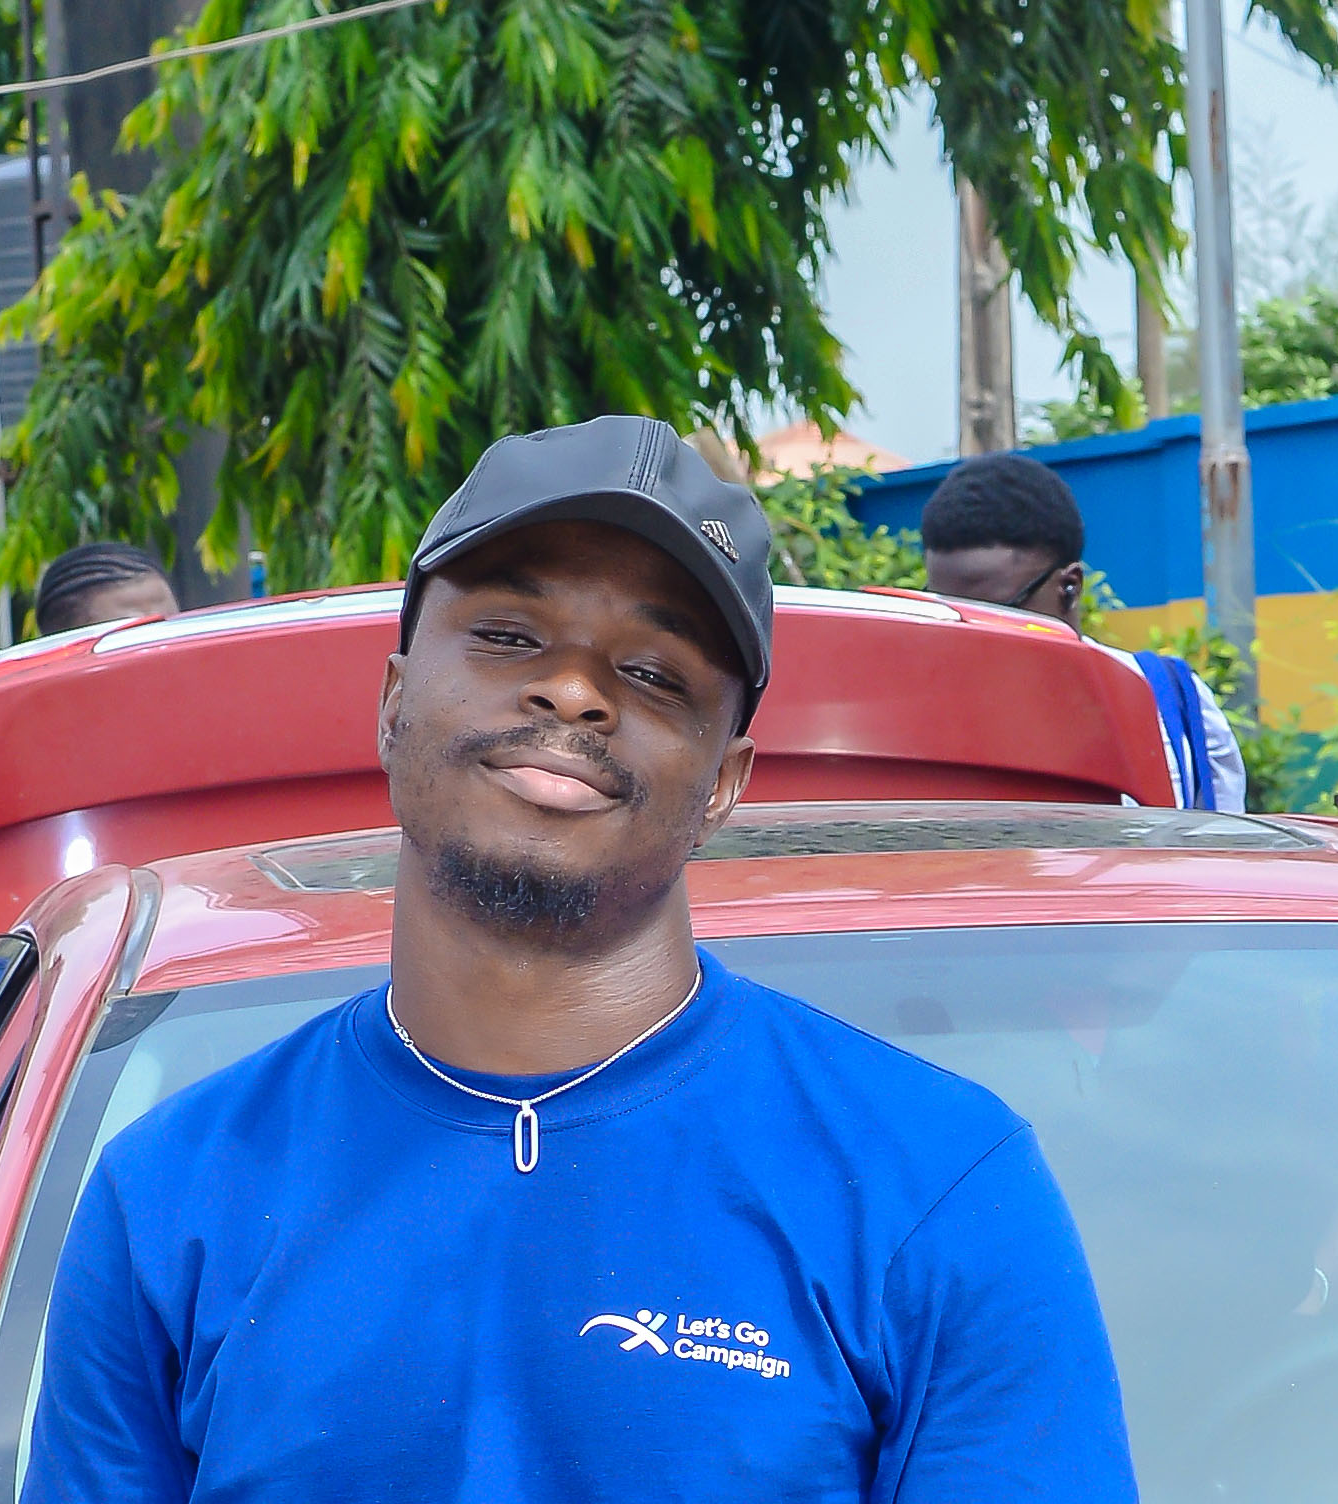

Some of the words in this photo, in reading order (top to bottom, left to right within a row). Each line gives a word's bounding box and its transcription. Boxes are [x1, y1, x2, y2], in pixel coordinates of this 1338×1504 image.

[676, 1313, 731, 1340] Let's
[733, 1321, 770, 1347] Go
[673, 1337, 790, 1378] Campaign
